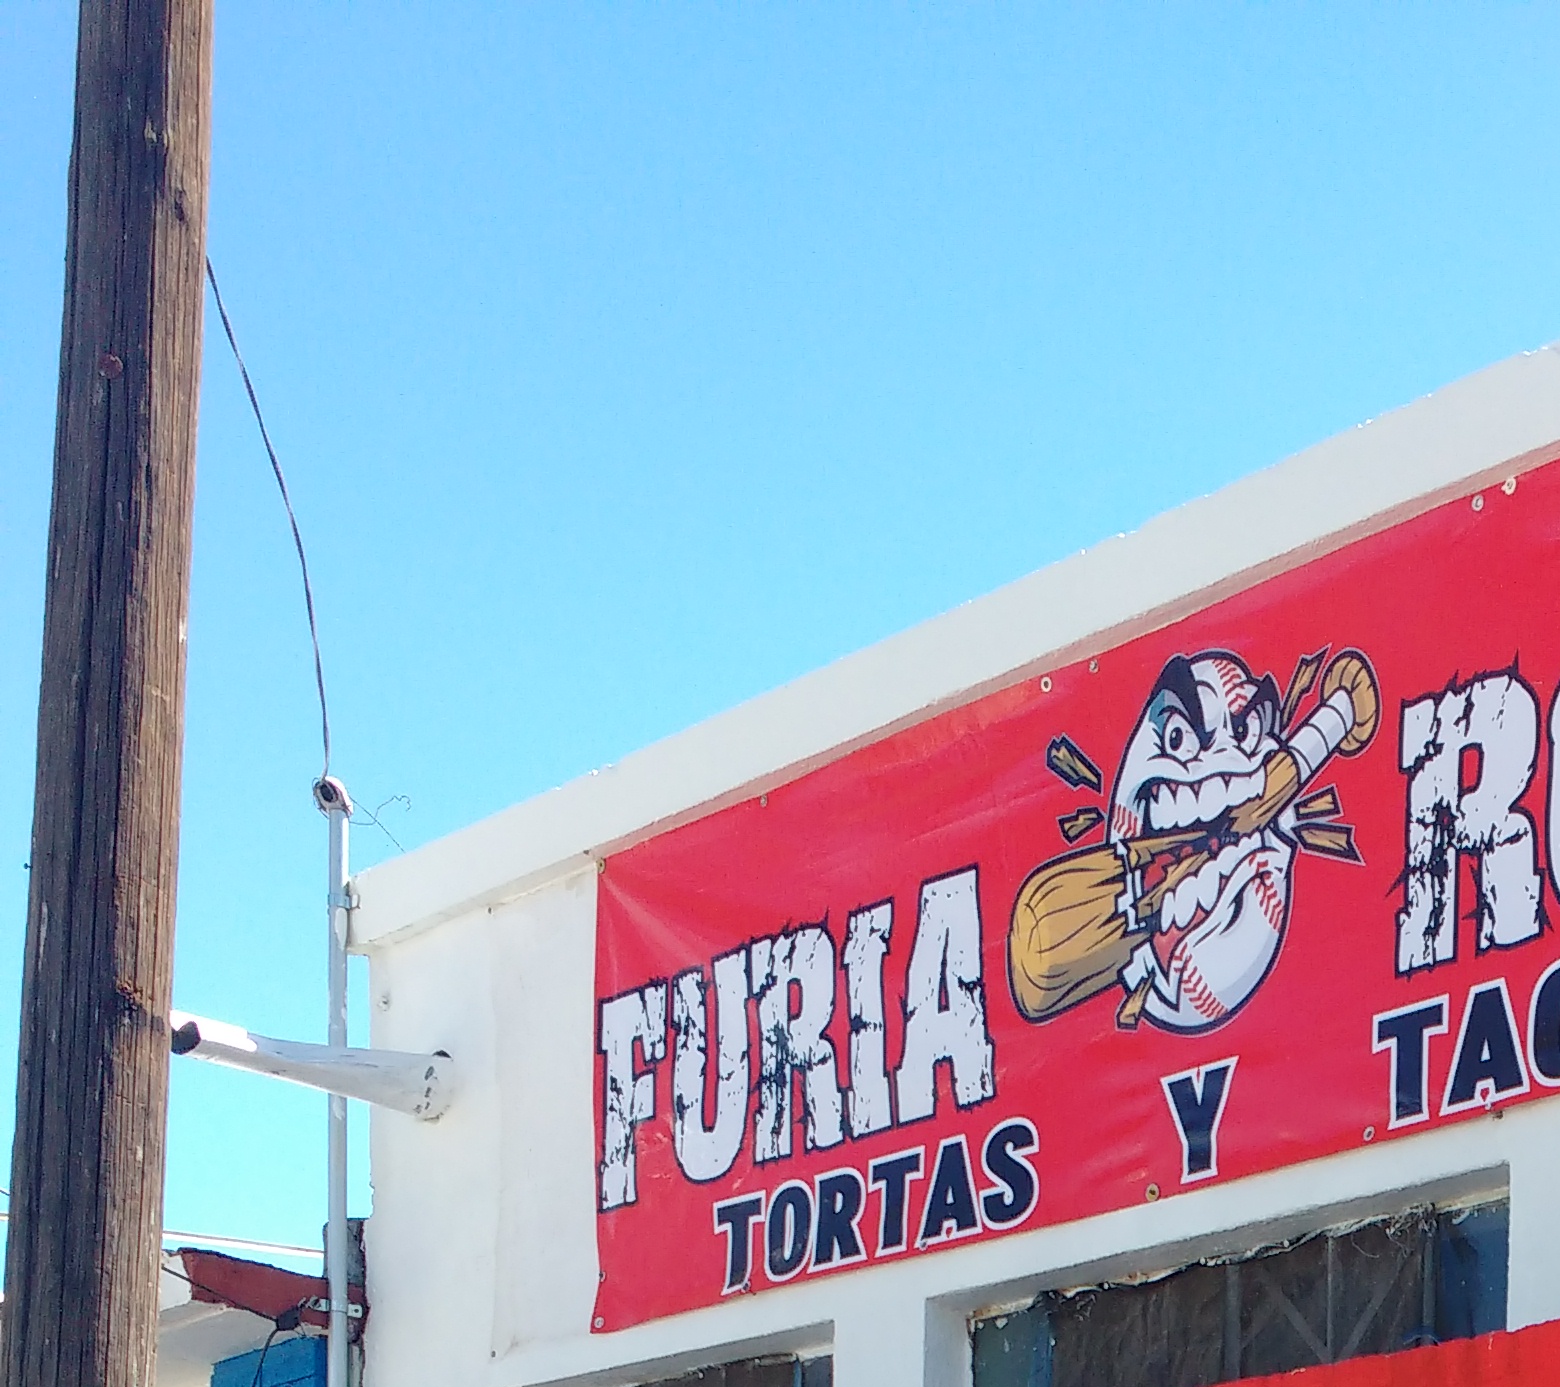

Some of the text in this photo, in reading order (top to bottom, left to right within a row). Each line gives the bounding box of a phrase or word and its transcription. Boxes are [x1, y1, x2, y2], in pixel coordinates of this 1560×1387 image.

[599, 862, 996, 1214] FURIA
[713, 1116, 1041, 1297] TORTAS
[1158, 1055, 1238, 1185] Y
